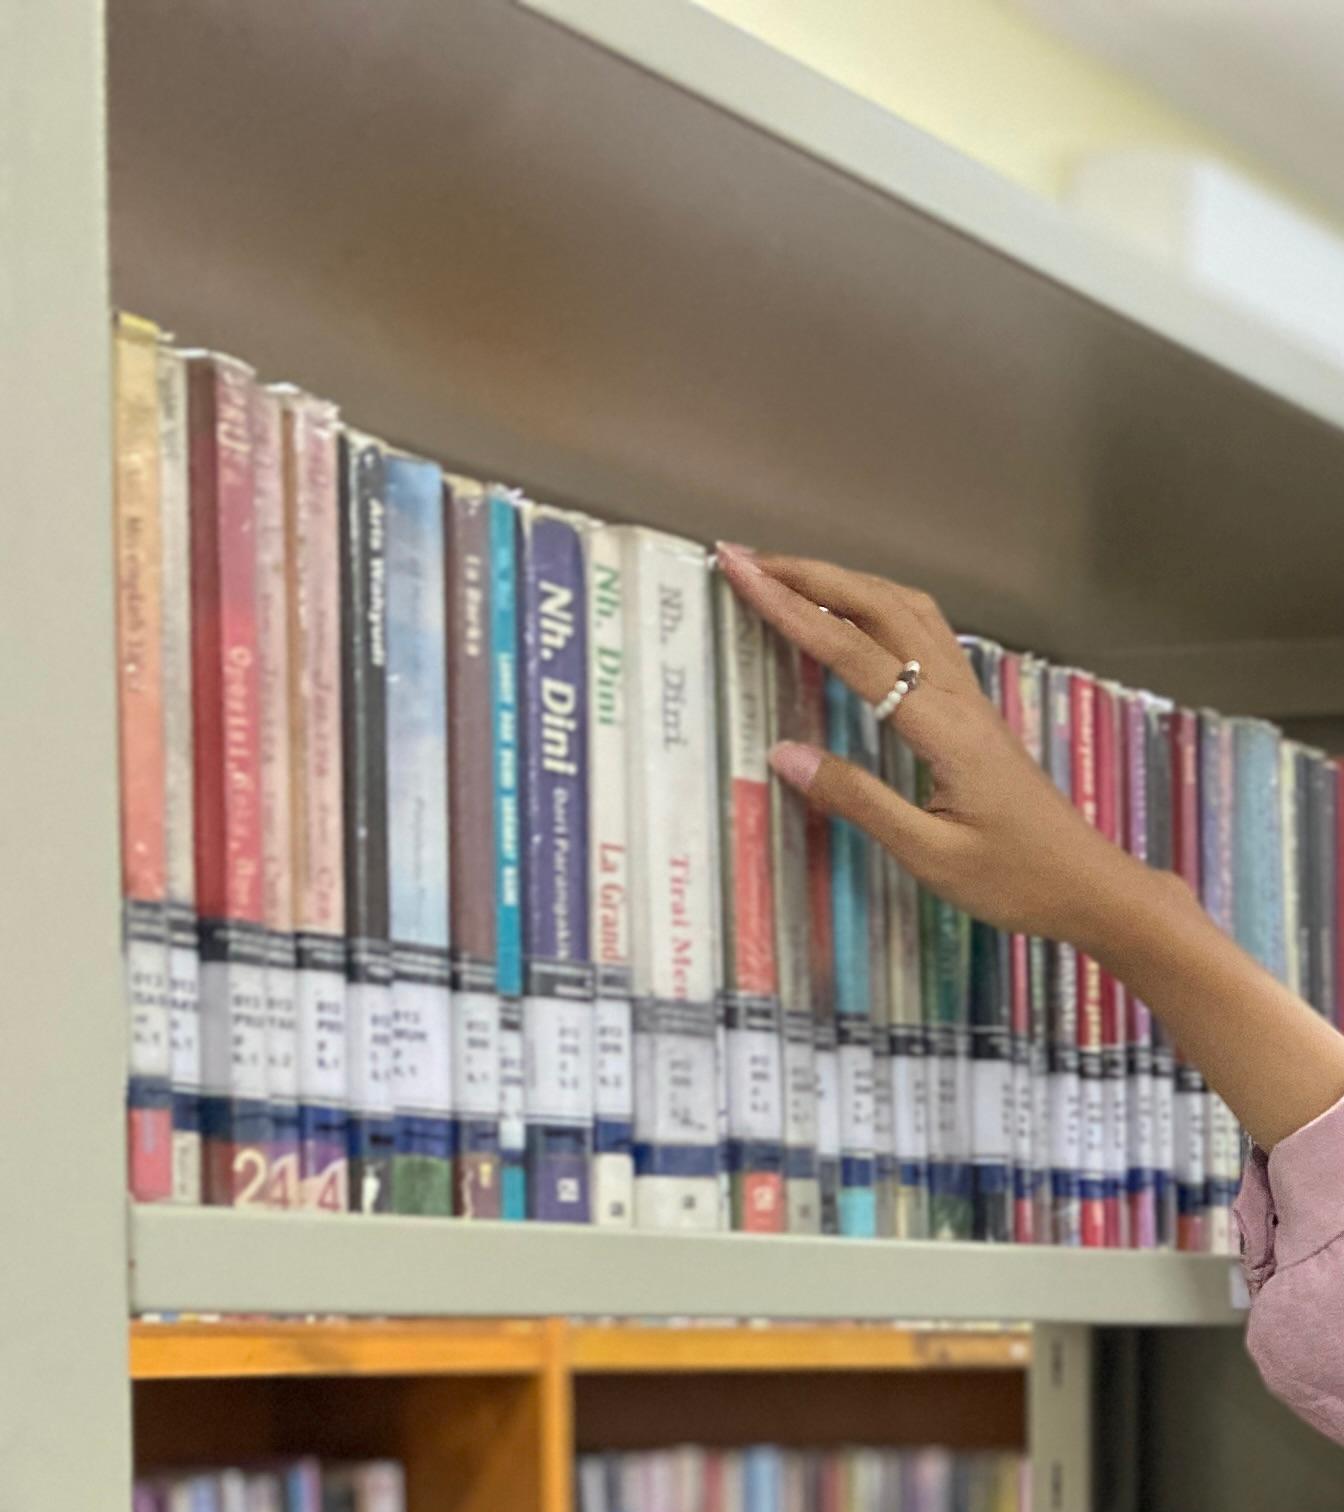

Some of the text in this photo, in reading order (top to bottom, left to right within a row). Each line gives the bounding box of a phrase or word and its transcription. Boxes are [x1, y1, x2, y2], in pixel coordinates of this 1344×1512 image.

[367, 558, 386, 666] Wahyudi
[538, 580, 578, 776] Nh. Dini
[595, 563, 624, 727] Nh. Dini
[658, 585, 688, 752] Nh. Dini
[600, 842, 626, 873] La
